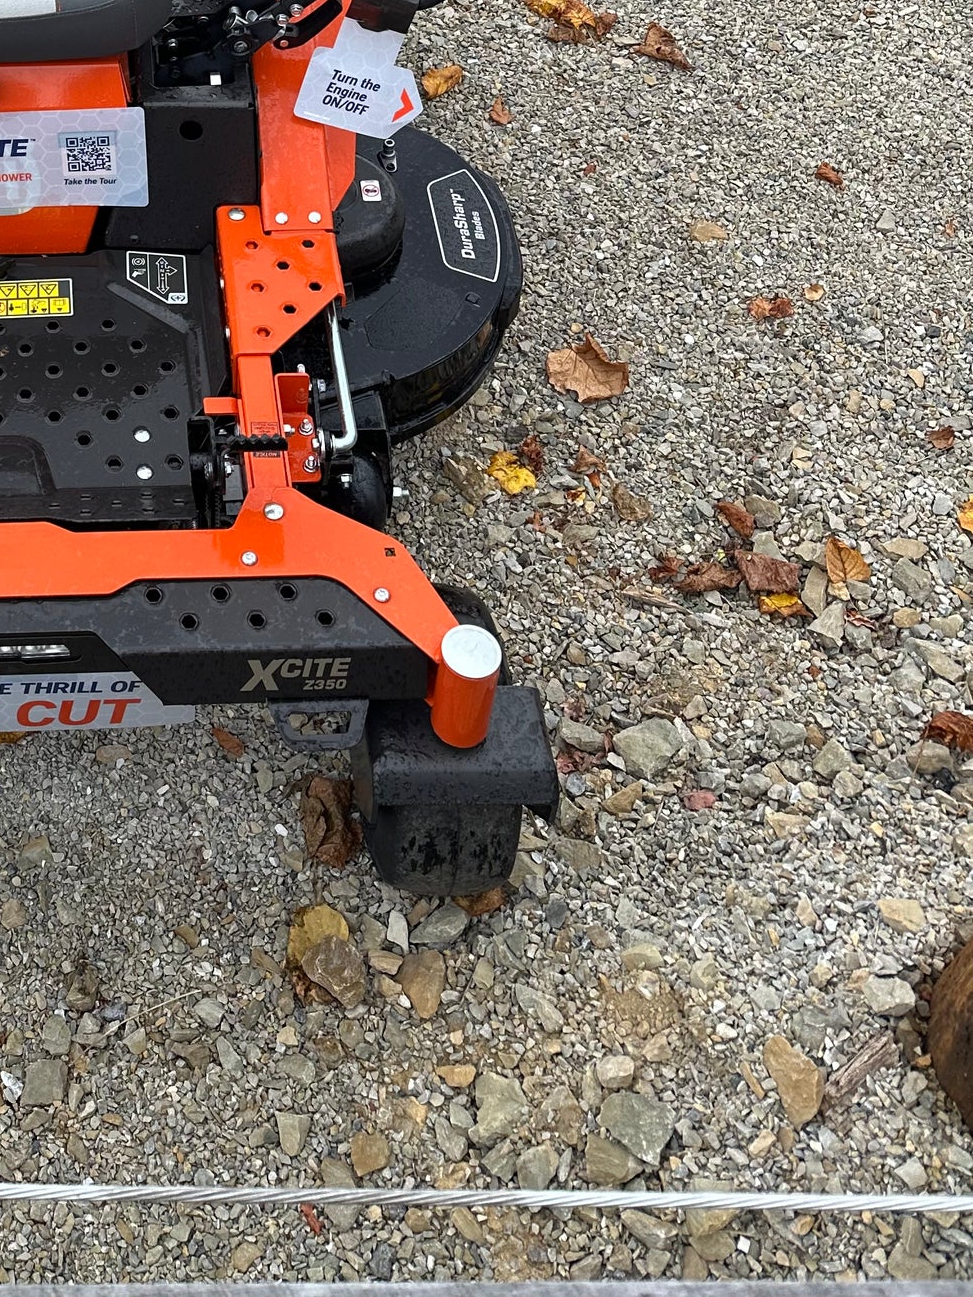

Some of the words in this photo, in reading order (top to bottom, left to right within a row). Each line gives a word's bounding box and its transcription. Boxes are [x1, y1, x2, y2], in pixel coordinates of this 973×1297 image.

[331, 69, 359, 86] Turn
[360, 78, 381, 92] the
[326, 82, 368, 102] Engine
[323, 95, 369, 115] ON/OFF
[99, 177, 117, 185] Tour
[451, 192, 476, 259] DuraSharp
[472, 211, 485, 240] Blades
[240, 658, 352, 692] XCITE
[303, 679, 347, 691] Z350
[20, 681, 102, 695] THRILL
[110, 680, 143, 693] OF
[16, 699, 142, 727] CUT
